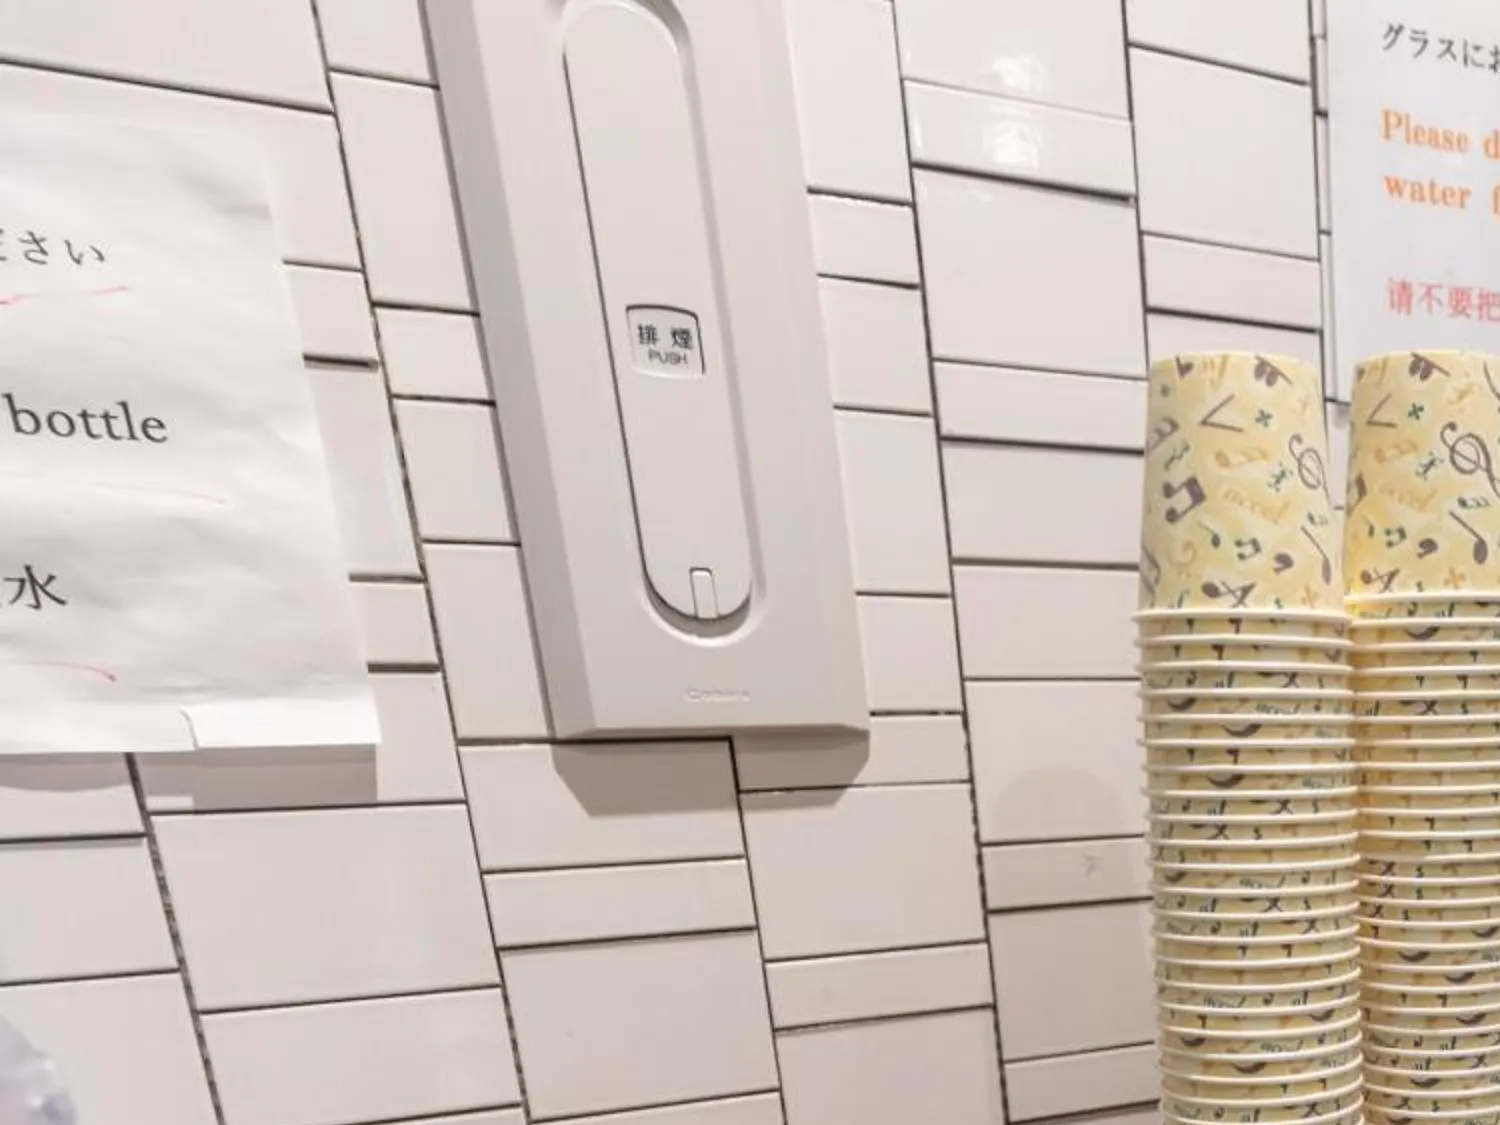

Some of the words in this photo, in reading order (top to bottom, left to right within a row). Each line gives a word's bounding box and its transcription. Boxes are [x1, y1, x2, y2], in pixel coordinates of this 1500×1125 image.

[1382, 108, 1471, 153] Please
[1384, 175, 1472, 209] water
[0, 228, 106, 266] さい
[647, 348, 688, 366] PUSH
[1, 392, 169, 443] bottle
